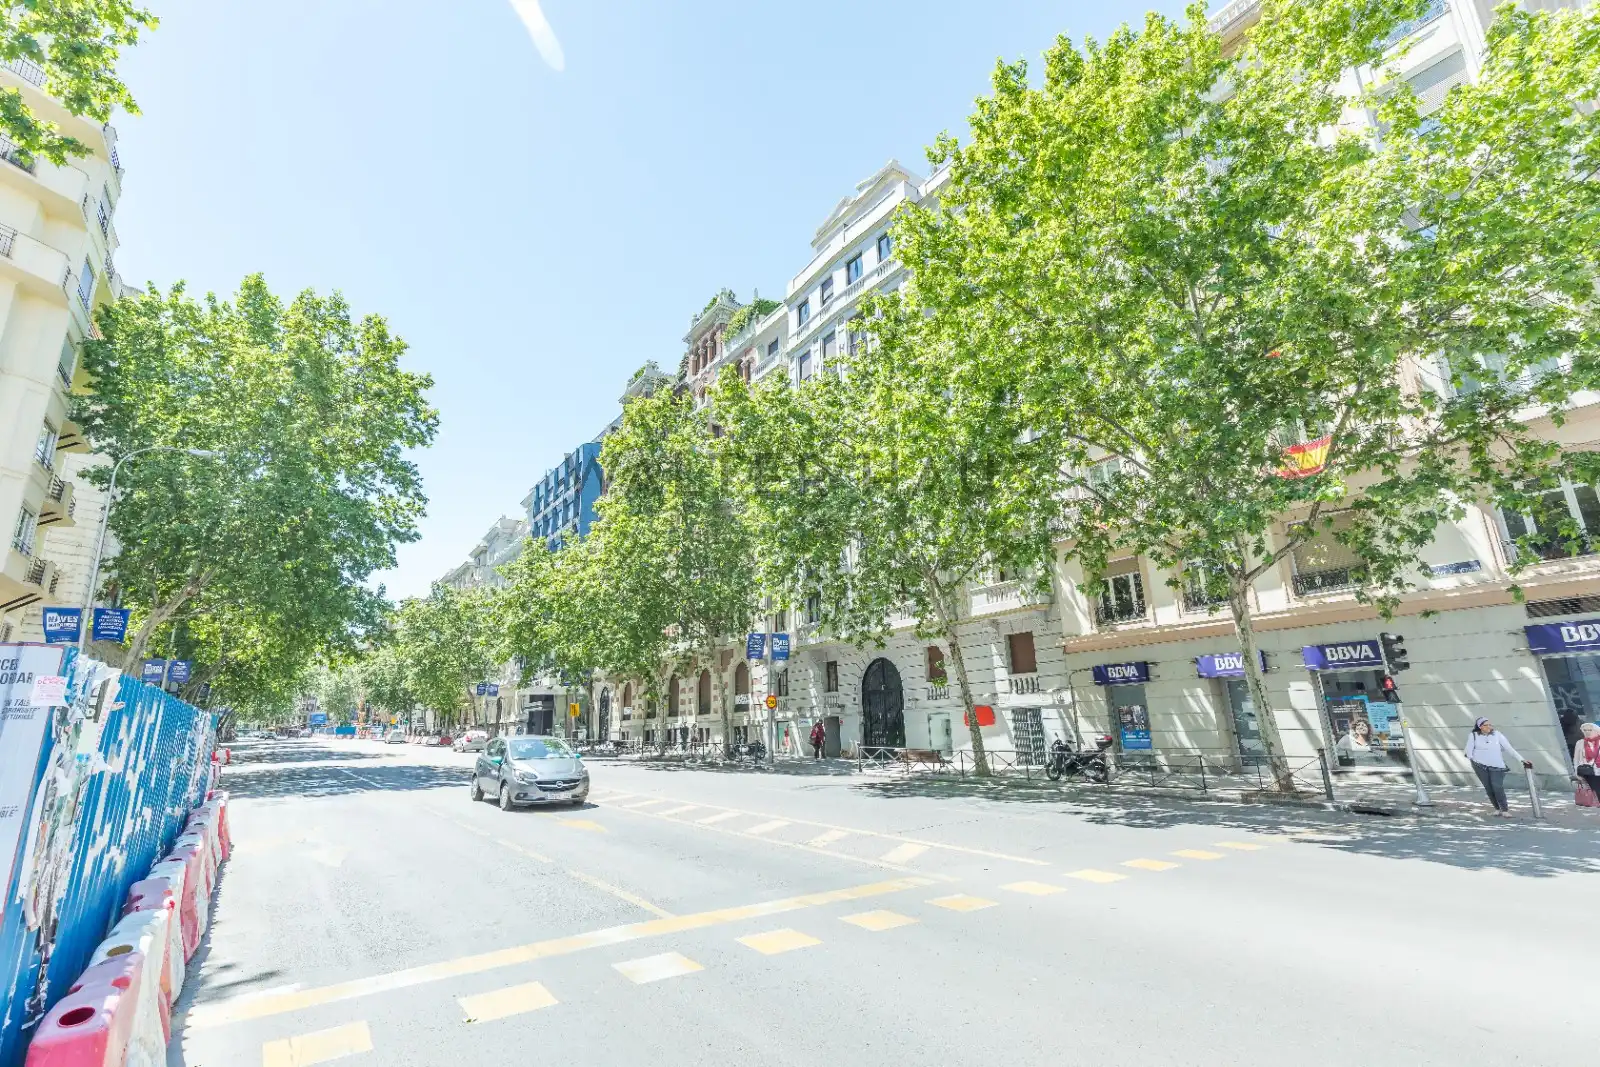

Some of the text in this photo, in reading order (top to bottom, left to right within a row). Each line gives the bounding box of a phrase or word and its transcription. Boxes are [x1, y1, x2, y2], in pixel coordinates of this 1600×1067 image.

[1325, 642, 1376, 662] BBVA
[1214, 655, 1245, 671] BBV
[1106, 665, 1139, 680] BBVA
